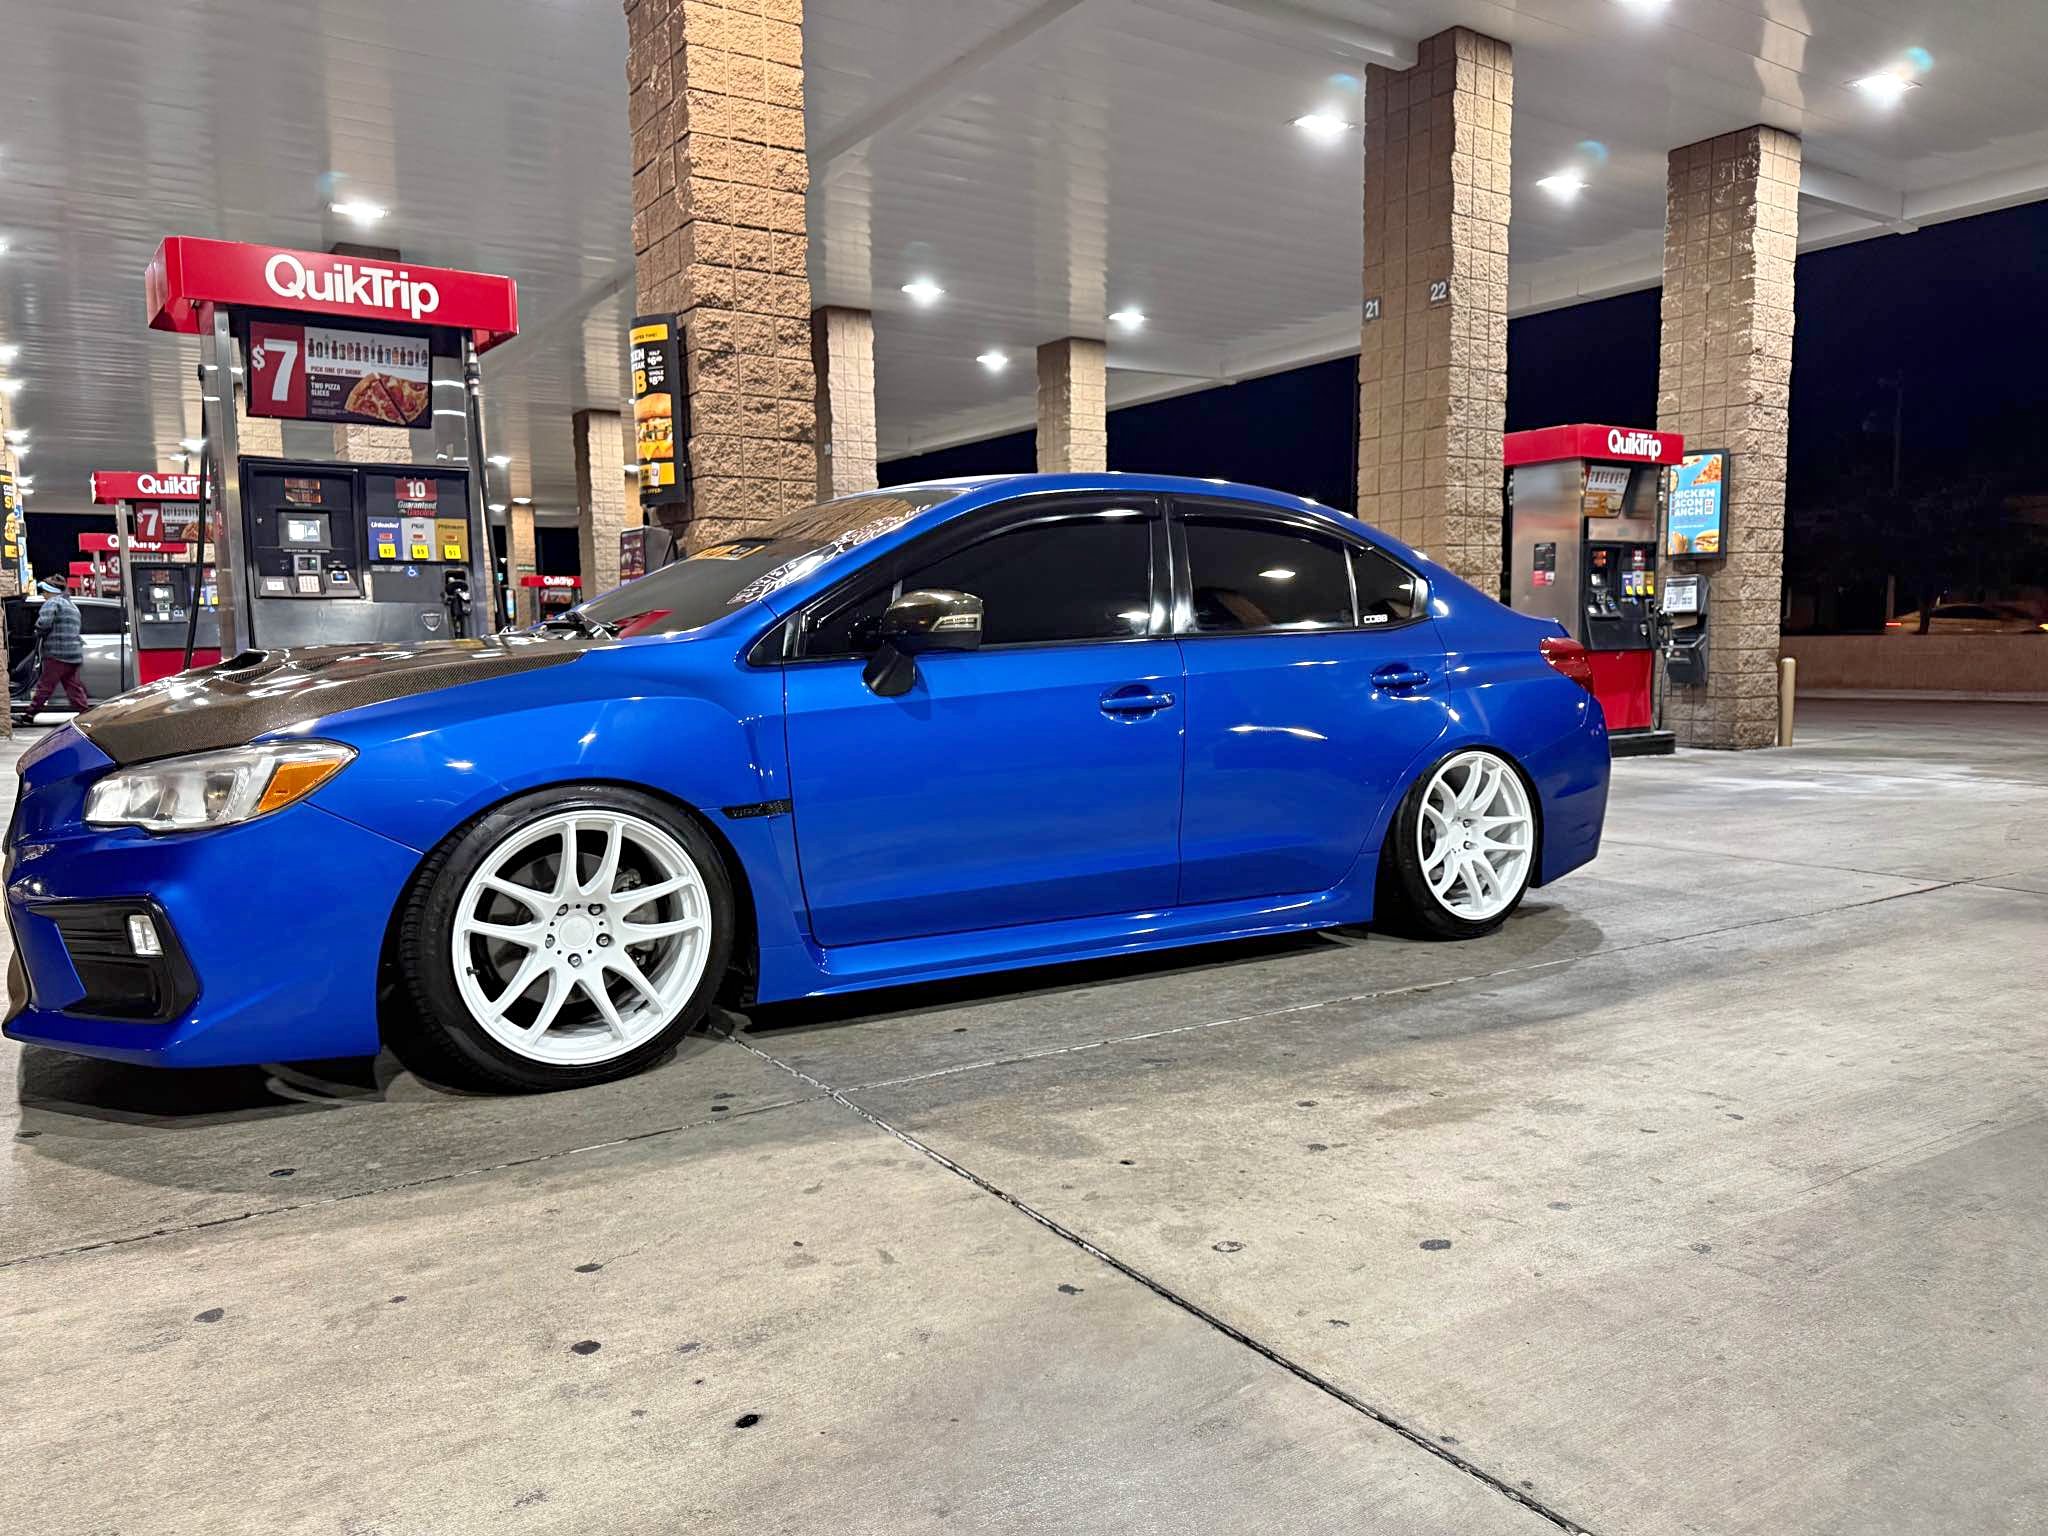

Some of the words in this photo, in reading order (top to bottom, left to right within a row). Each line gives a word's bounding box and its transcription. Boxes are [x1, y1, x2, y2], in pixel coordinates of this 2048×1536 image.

[265, 254, 440, 319] QuikTrip
[1430, 281, 1447, 302] 22
[1365, 299, 1379, 319] 21
[252, 338, 299, 402] $7
[1608, 429, 1662, 461] QuikTrip
[137, 474, 211, 499] QuikTr
[407, 481, 426, 498] 10
